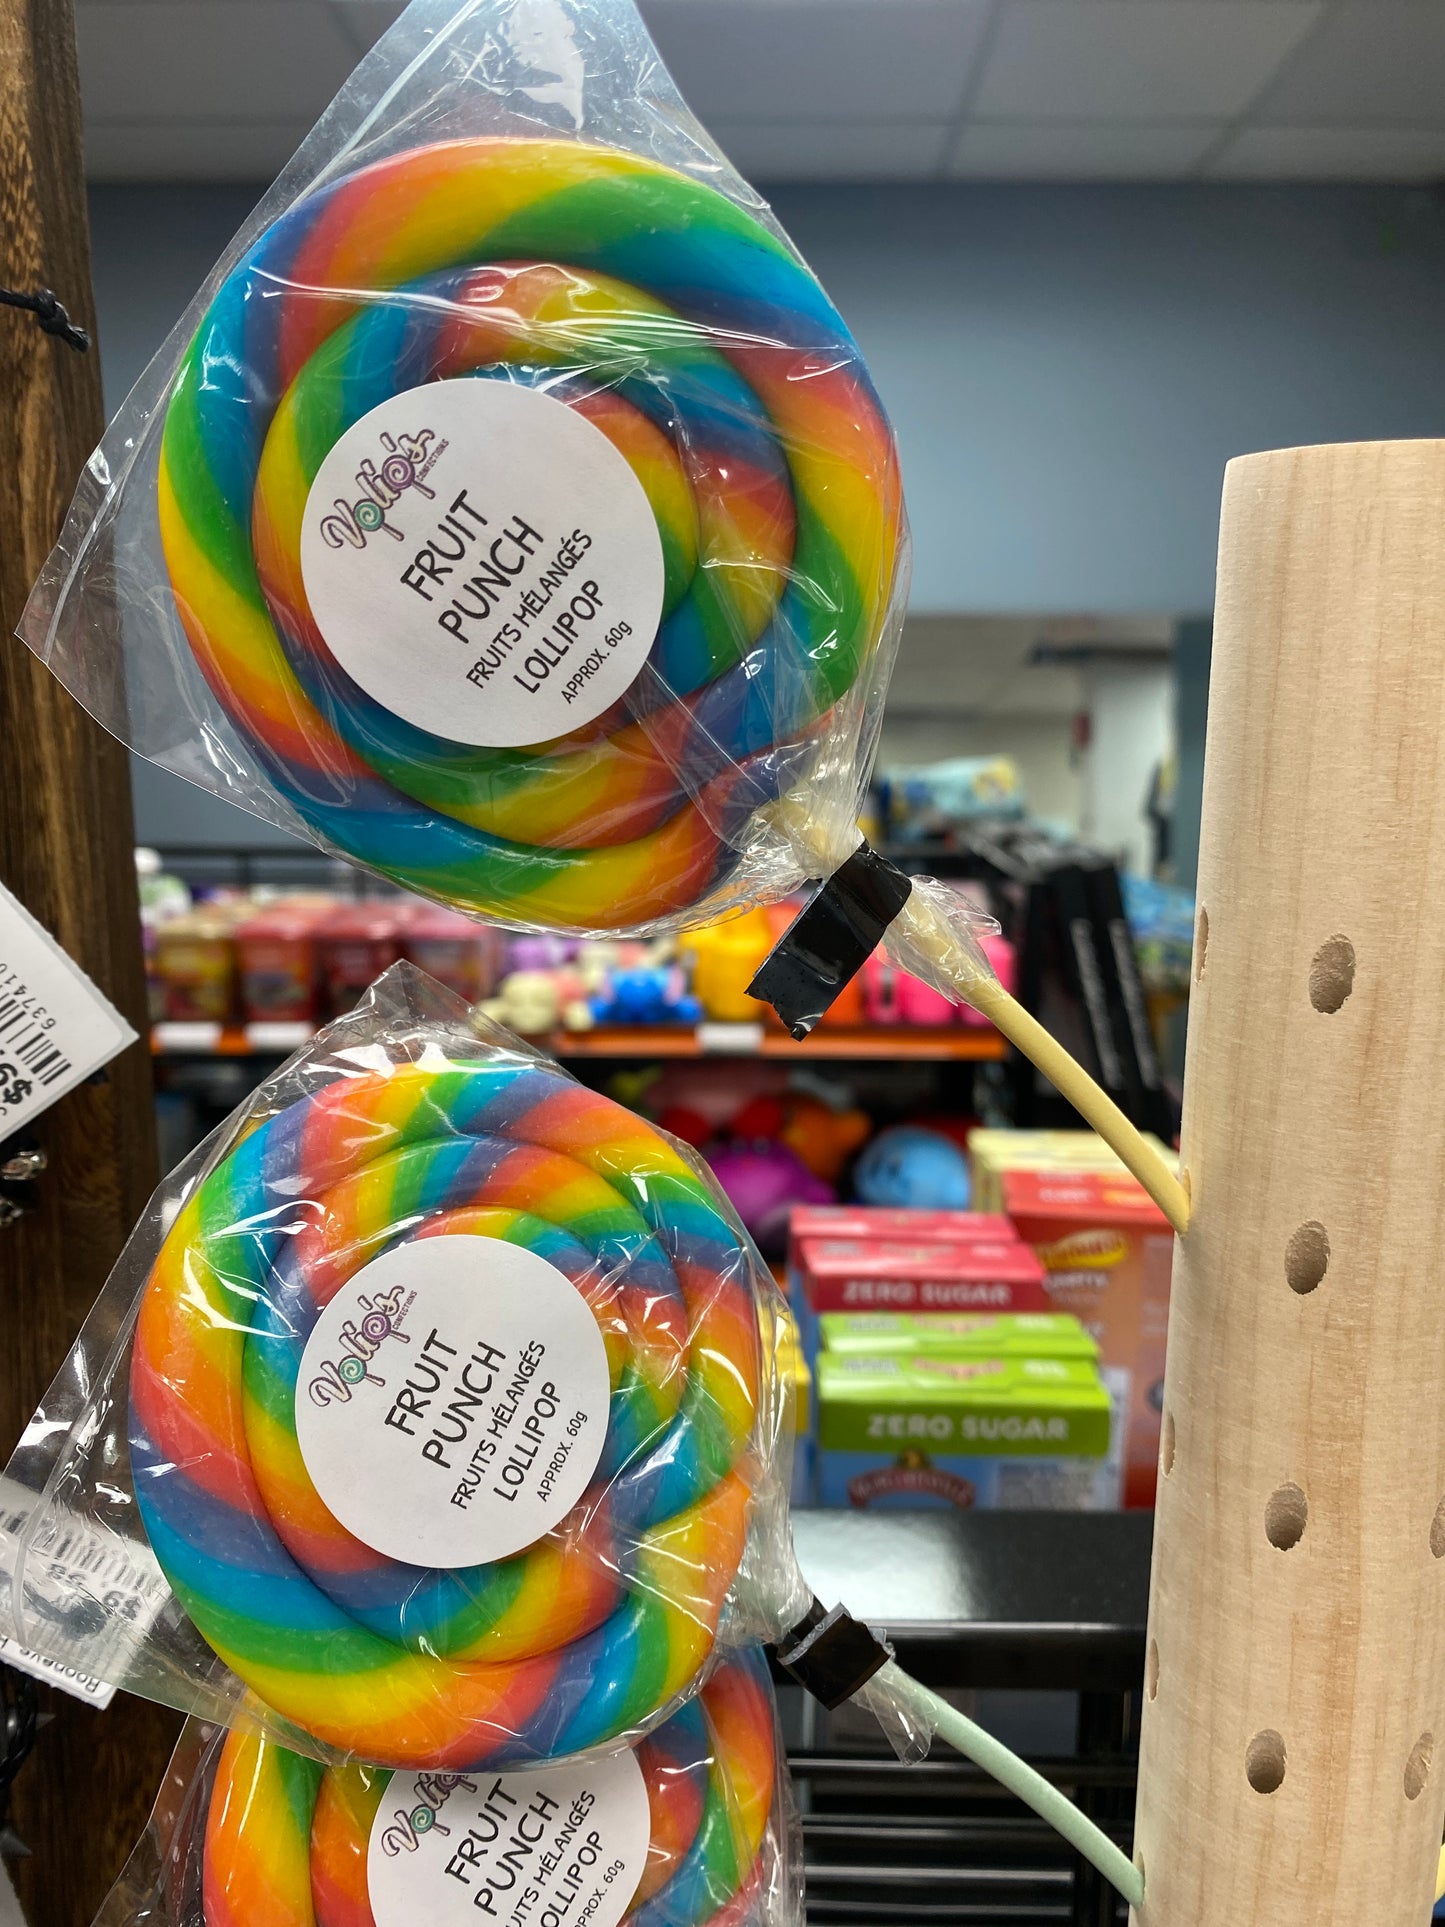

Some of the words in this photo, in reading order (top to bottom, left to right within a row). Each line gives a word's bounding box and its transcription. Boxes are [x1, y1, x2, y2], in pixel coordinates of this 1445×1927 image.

[400, 488, 489, 602] FRUIT
[438, 515, 544, 645] PUNCH
[466, 622, 522, 689] FRUITS
[512, 528, 593, 629] MÉLANGÉS
[512, 579, 604, 694] LOLLIPOP
[560, 647, 613, 705] APPROX.
[604, 620, 633, 648] 60g
[843, 1280, 915, 1302] ZERO
[922, 1281, 1013, 1304] SUGAR
[384, 1328, 457, 1436] FRUIT
[421, 1340, 507, 1469] PUNCH
[450, 1439, 497, 1510] FRUITS
[486, 1340, 546, 1440] MÉLANGÉS
[867, 1414, 954, 1440] ZERO
[961, 1414, 1069, 1441] SUGAR
[492, 1381, 561, 1502] LOLLIPOP
[536, 1441, 574, 1503] APPROX.
[566, 1410, 589, 1437] 60g
[444, 1776, 518, 1885] FRUIT
[473, 1790, 560, 1917] PUNCH
[533, 1790, 596, 1886] MÉLANGÉS
[540, 1830, 603, 1927] OLLIPOP
[603, 1859, 626, 1884] 60g
